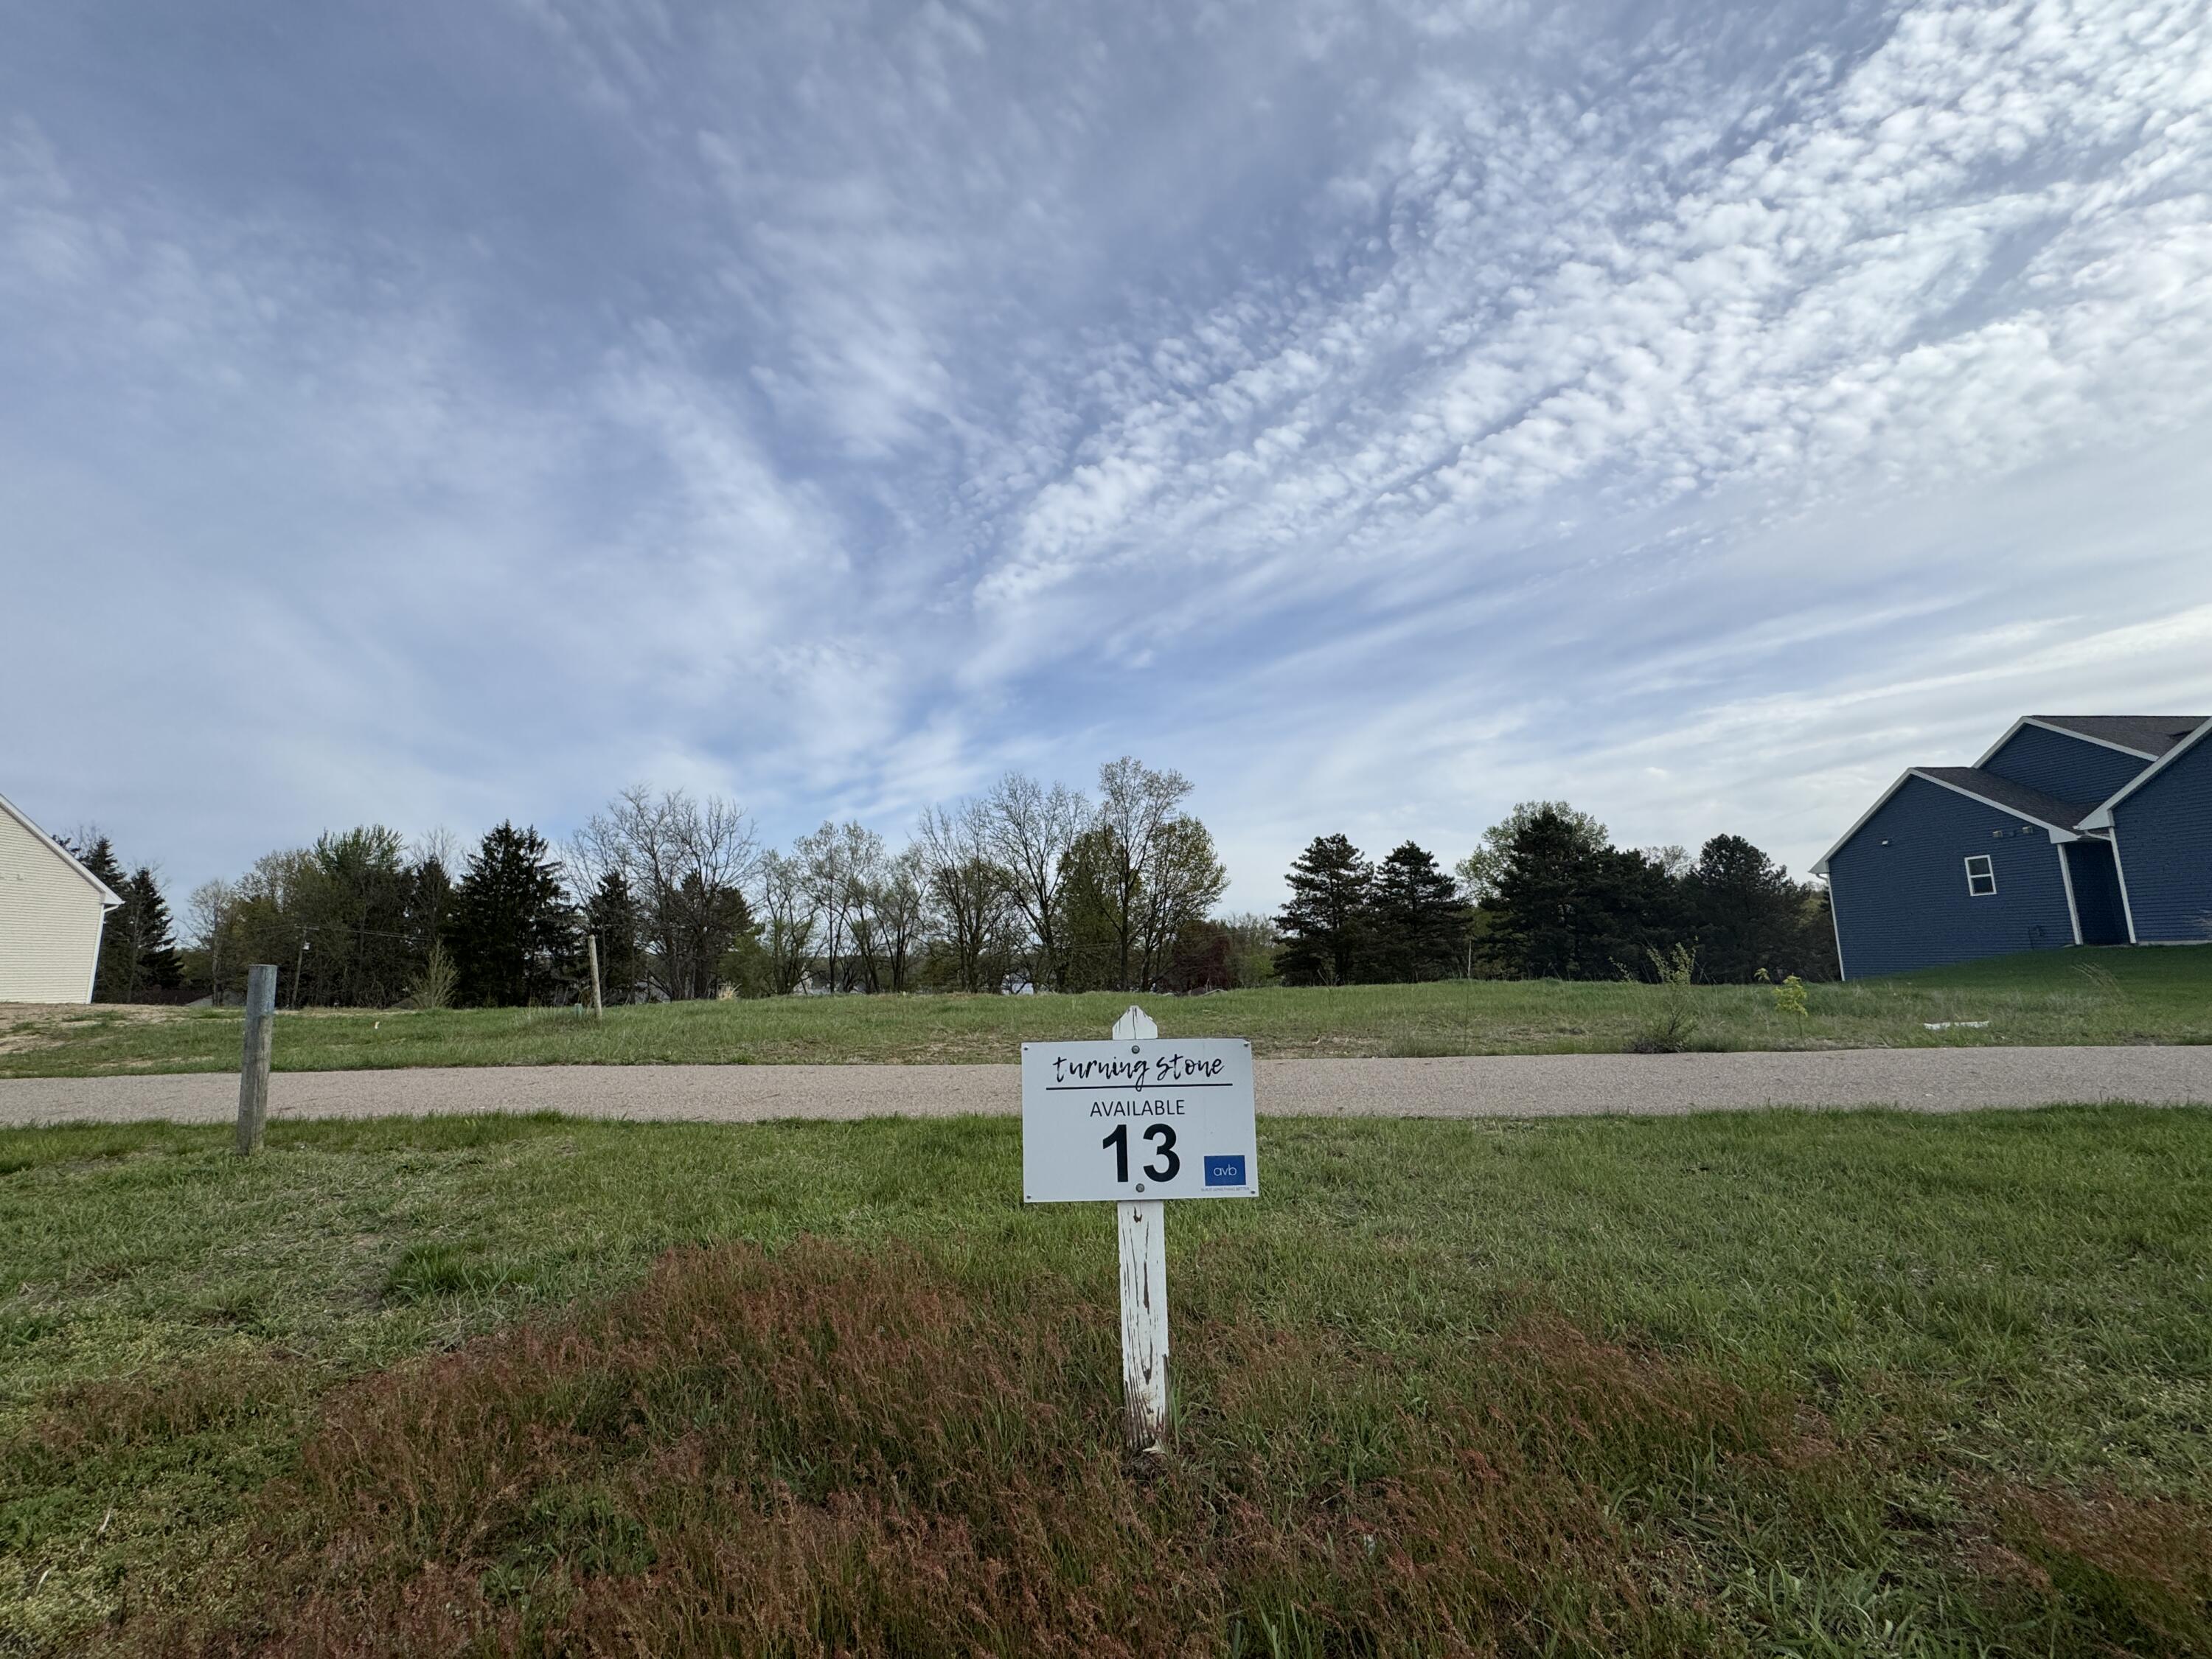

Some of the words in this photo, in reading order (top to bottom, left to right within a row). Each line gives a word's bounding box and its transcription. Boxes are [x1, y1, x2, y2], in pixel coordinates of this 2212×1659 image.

[1053, 1056, 1150, 1091] turning
[1156, 1053, 1224, 1080] stone
[1090, 1099, 1186, 1117] AVAILABLE
[1102, 1123, 1180, 1183] 13
[1213, 1164, 1237, 1177] avb
